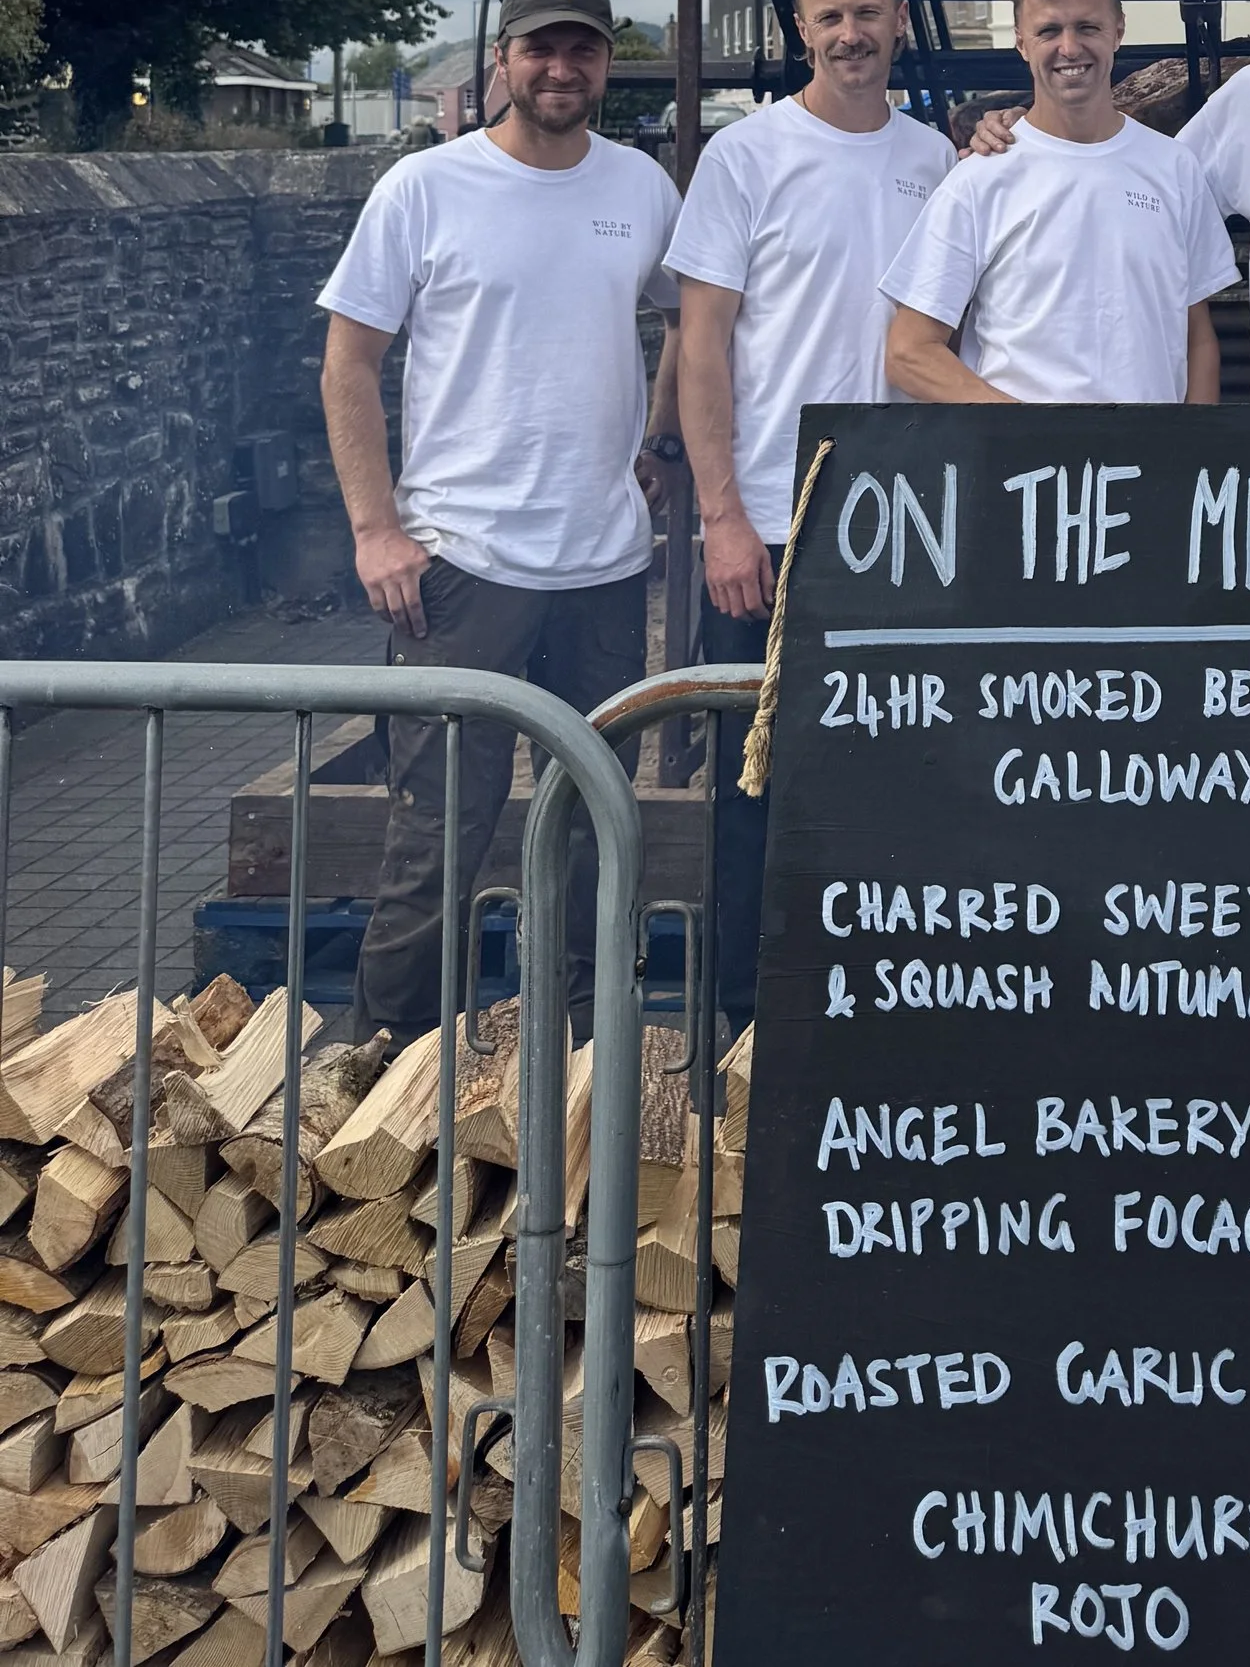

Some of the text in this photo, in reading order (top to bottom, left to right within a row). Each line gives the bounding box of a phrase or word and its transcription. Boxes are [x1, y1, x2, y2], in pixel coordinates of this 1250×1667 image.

[895, 179, 927, 193] WILD BY
[1125, 191, 1160, 205] WILD BY
[1127, 199, 1160, 213] NATURE
[592, 220, 632, 230] WILD BY
[594, 229, 632, 238] NATURE
[838, 464, 957, 587] ON
[1003, 458, 1141, 584] THE
[820, 671, 952, 738] 24HR
[979, 670, 1161, 725] SMOKED
[822, 882, 1060, 938] CHARRED
[825, 965, 855, 1018] &
[875, 959, 1053, 1013] SQUASH
[818, 1097, 1005, 1171] ANGEL
[822, 1193, 1074, 1257] DRIPPING
[764, 1353, 1010, 1422] ROASTED
[1056, 1341, 1246, 1406] GARLIC
[1032, 1582, 1188, 1650] ROJO
